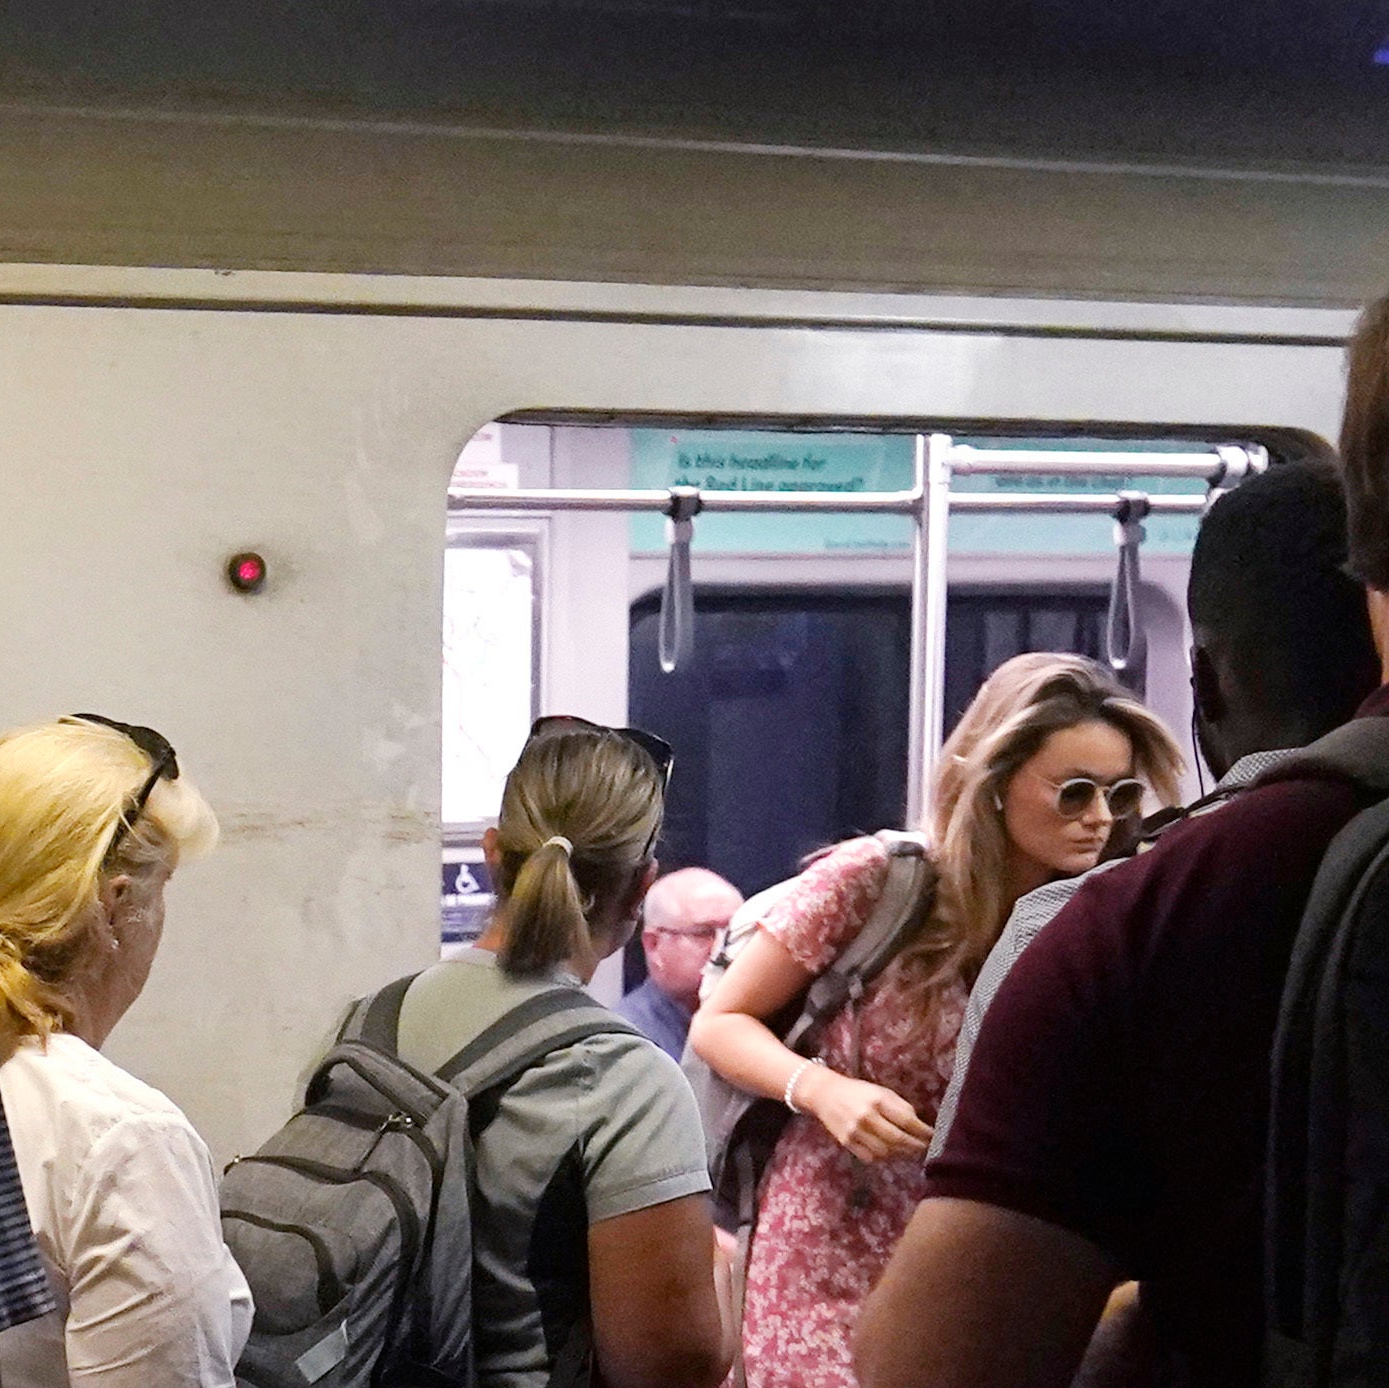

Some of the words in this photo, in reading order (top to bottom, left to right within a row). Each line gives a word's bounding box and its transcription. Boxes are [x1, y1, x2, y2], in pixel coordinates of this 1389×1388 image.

[695, 453, 725, 469] this
[729, 453, 800, 470] headline
[802, 453, 827, 471] for
[705, 475, 737, 491] Red
